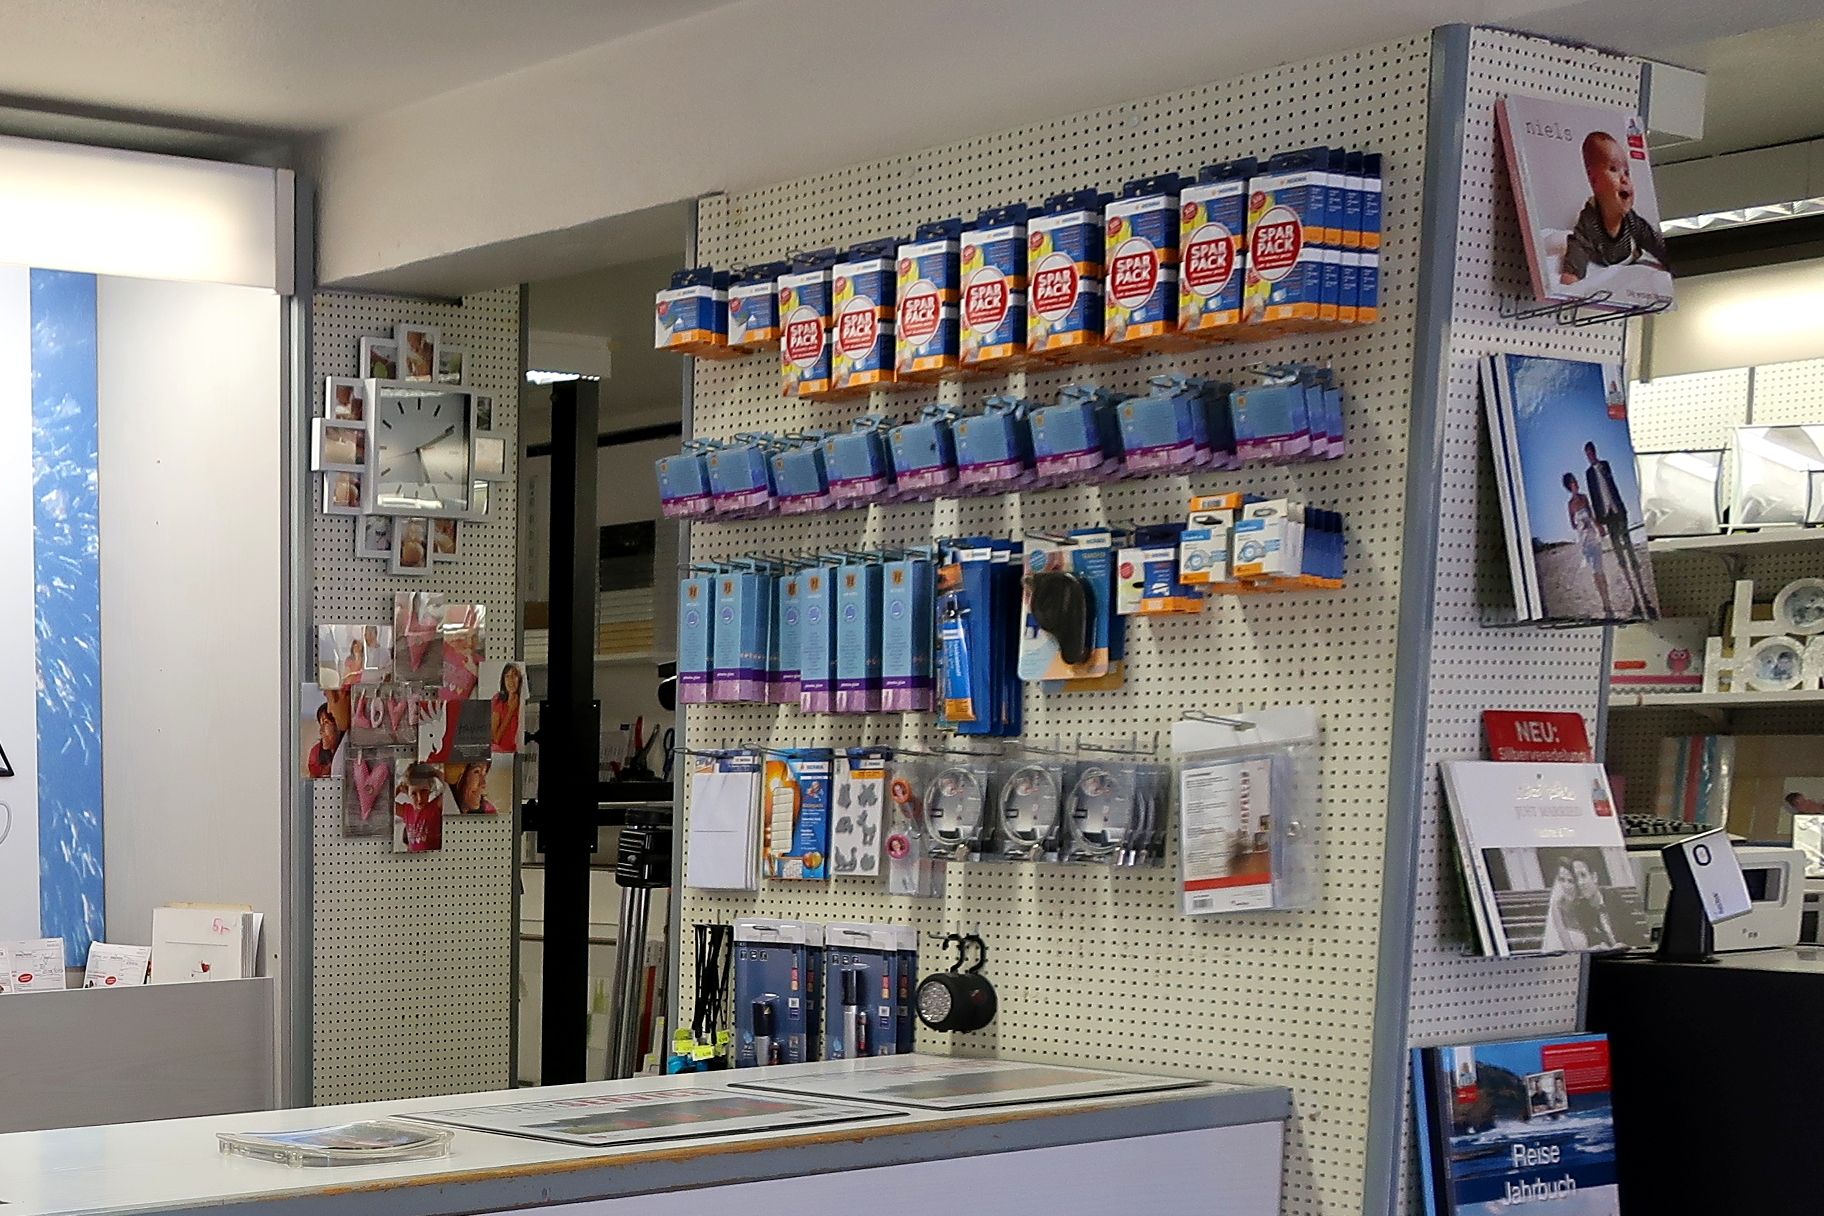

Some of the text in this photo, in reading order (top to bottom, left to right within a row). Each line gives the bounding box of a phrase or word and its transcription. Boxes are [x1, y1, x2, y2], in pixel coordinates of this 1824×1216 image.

[1526, 121, 1573, 142] niels
[1258, 225, 1295, 240] SPAR
[1191, 241, 1227, 257] SPAR
[1257, 239, 1294, 257] PACK
[1117, 255, 1151, 270] SPAR
[1190, 255, 1227, 272] PACK
[1037, 269, 1072, 286] SPAR
[1116, 268, 1151, 284] PACK
[969, 283, 1001, 298] SPAR
[1037, 282, 1072, 300] PACK
[906, 297, 935, 313] SPAR
[969, 296, 1002, 311] PACK
[844, 312, 873, 325] SPAR
[904, 310, 936, 325] PACK
[790, 322, 818, 334] SPAR
[843, 324, 873, 339] PACK
[790, 334, 818, 347] PACK
[1515, 720, 1560, 743] NEU:
[1511, 1142, 1560, 1168] Reise
[1503, 1174, 1576, 1206] Jahrbuch
